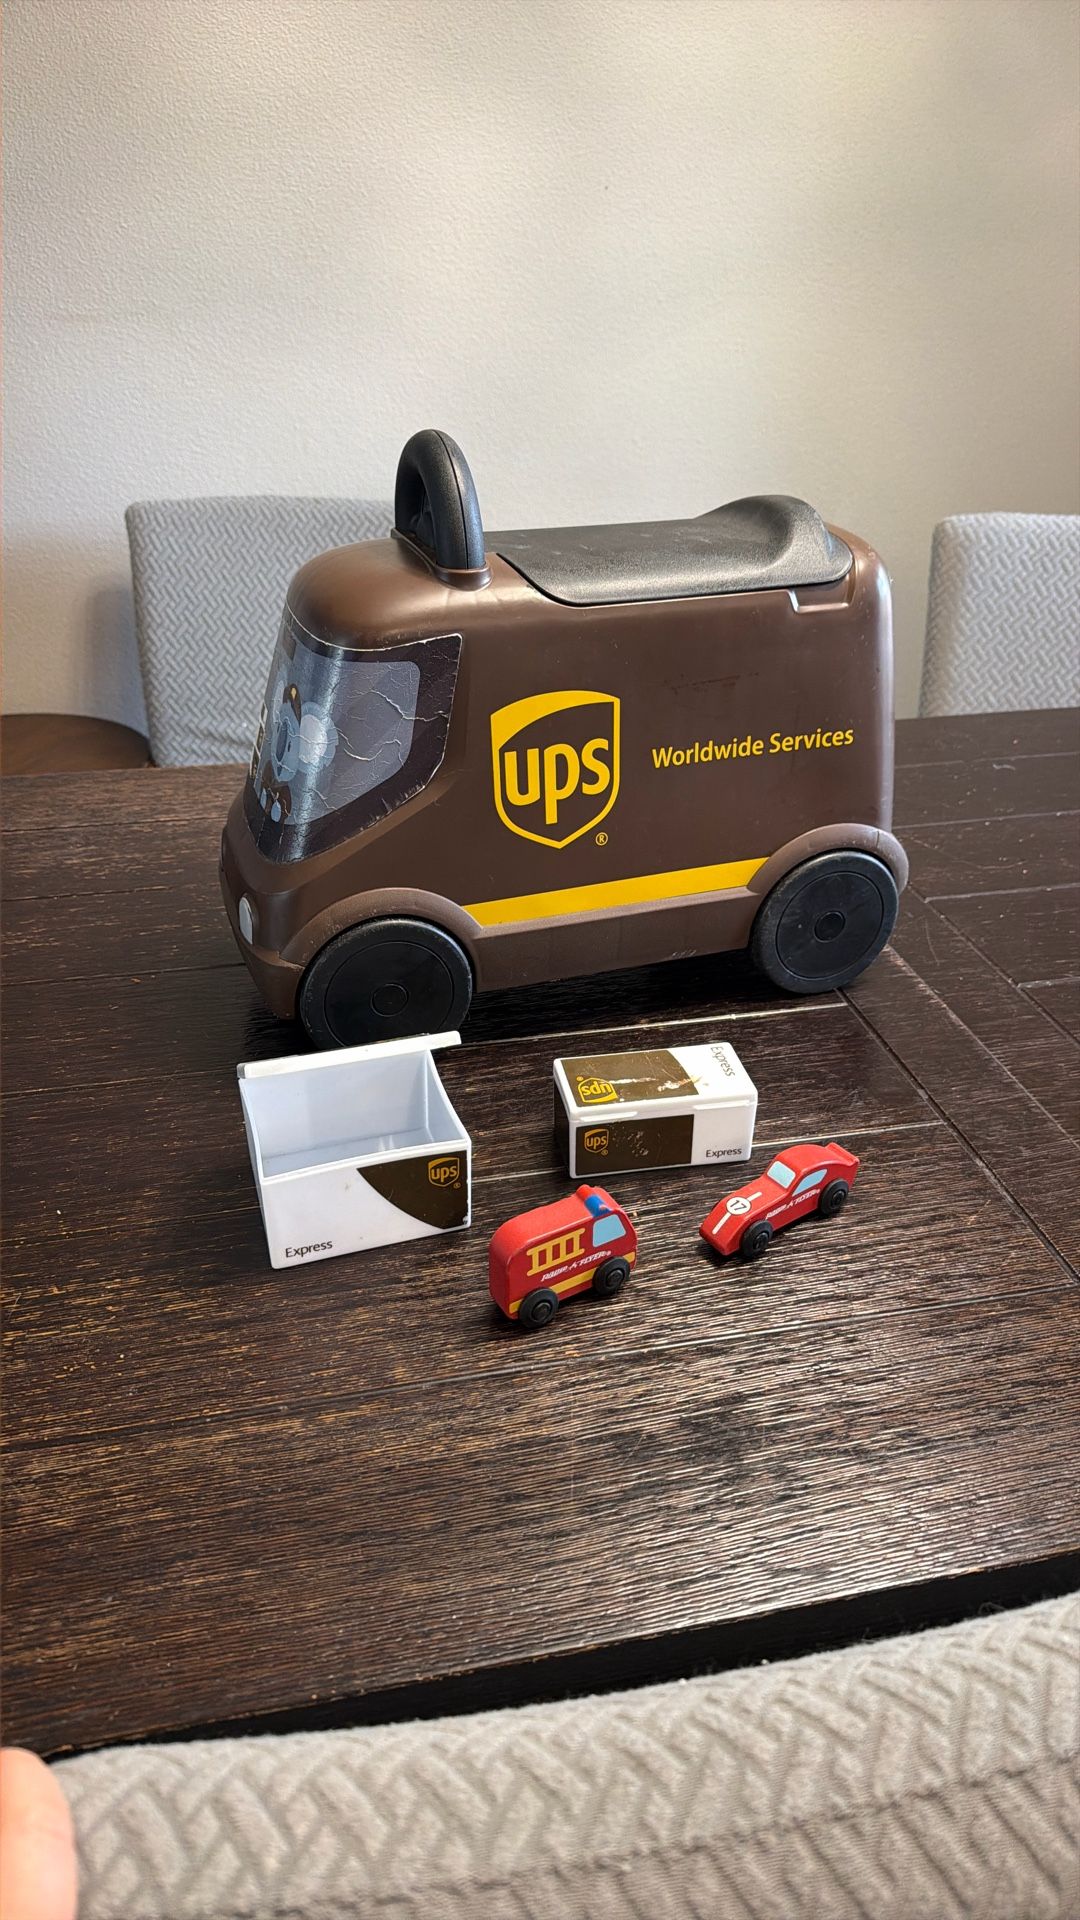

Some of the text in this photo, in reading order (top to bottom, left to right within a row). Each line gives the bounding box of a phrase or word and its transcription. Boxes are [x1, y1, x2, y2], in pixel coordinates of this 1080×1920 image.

[652, 728, 854, 769] Worldwide Services
[504, 737, 611, 825] ups
[710, 1046, 736, 1077] Express
[580, 1080, 613, 1096] ups
[586, 1135, 608, 1150] ups
[705, 1147, 743, 1159] Express
[430, 1165, 457, 1183] ups
[730, 1199, 748, 1212] 17
[285, 1240, 333, 1259] Express
